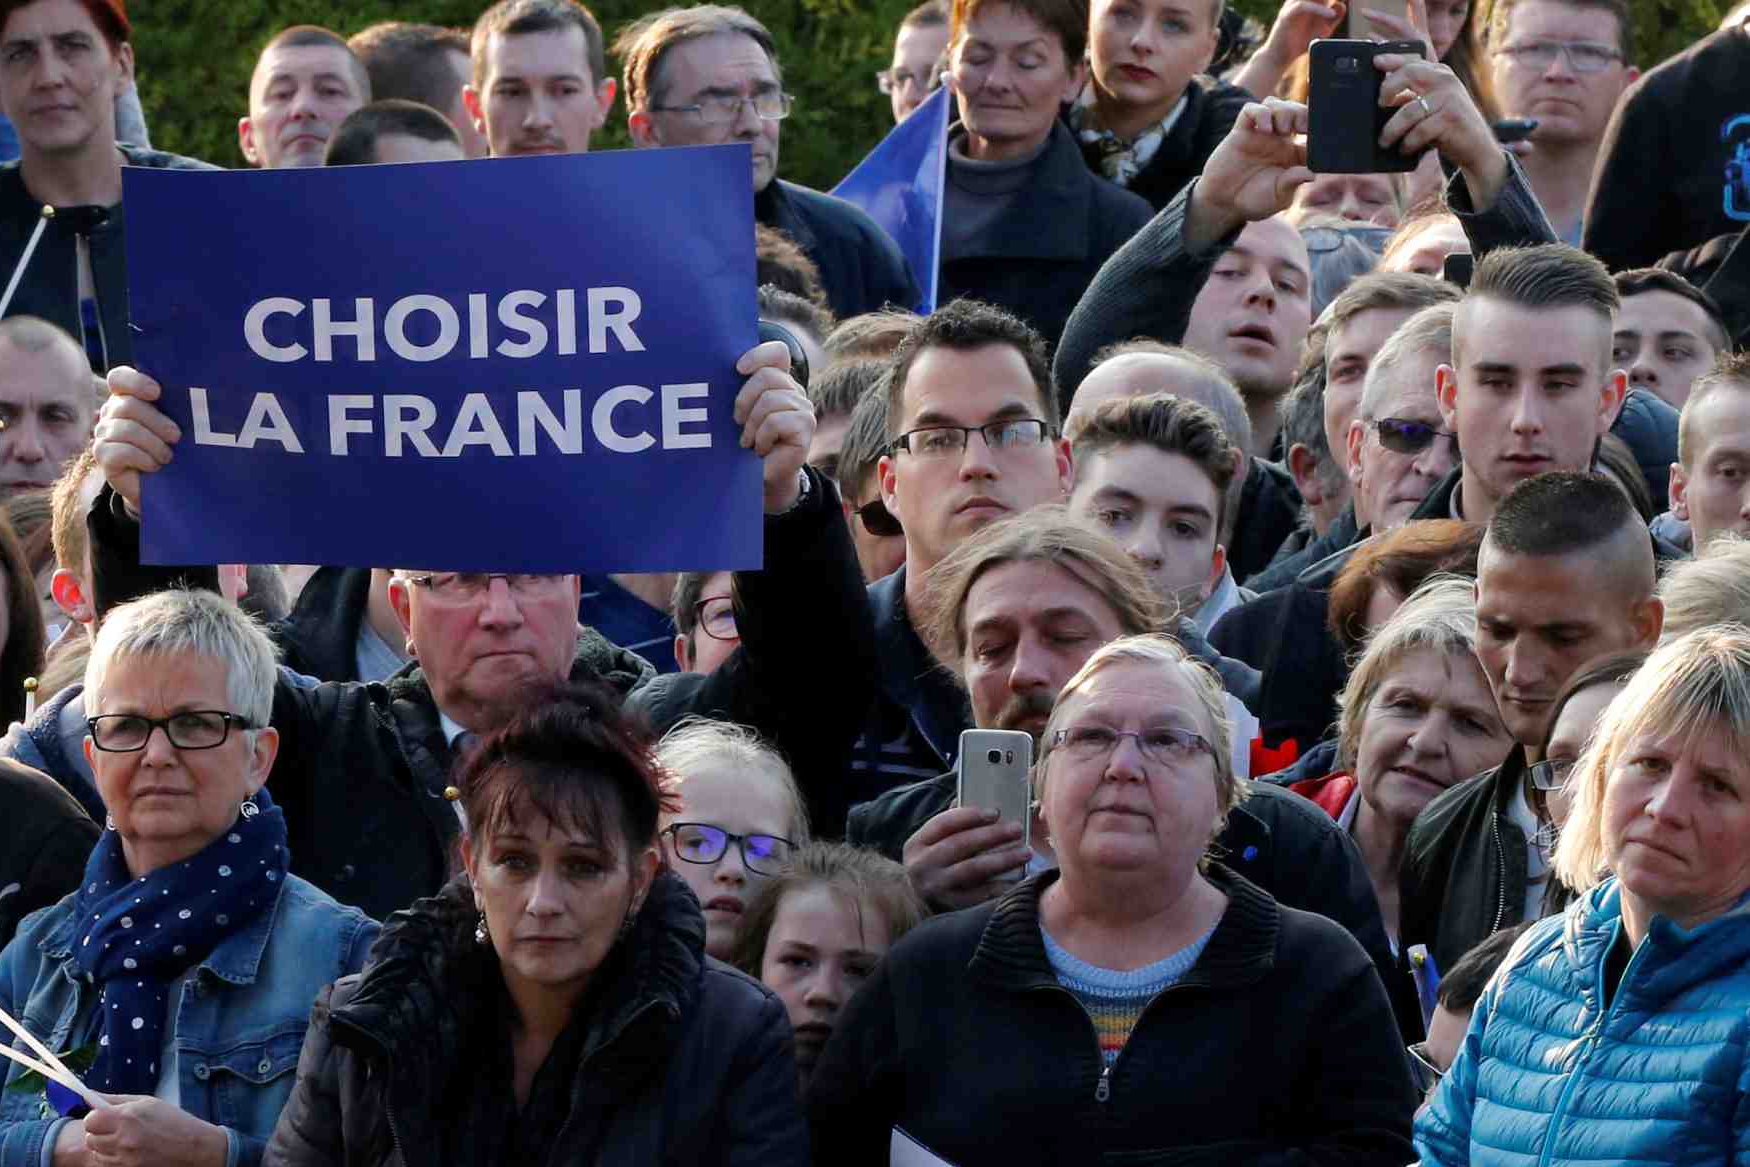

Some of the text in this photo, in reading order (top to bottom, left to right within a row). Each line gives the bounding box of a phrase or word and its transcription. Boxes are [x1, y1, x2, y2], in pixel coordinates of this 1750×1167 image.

[243, 286, 646, 362] CHOISIR
[188, 382, 713, 458] LA FRANCE
